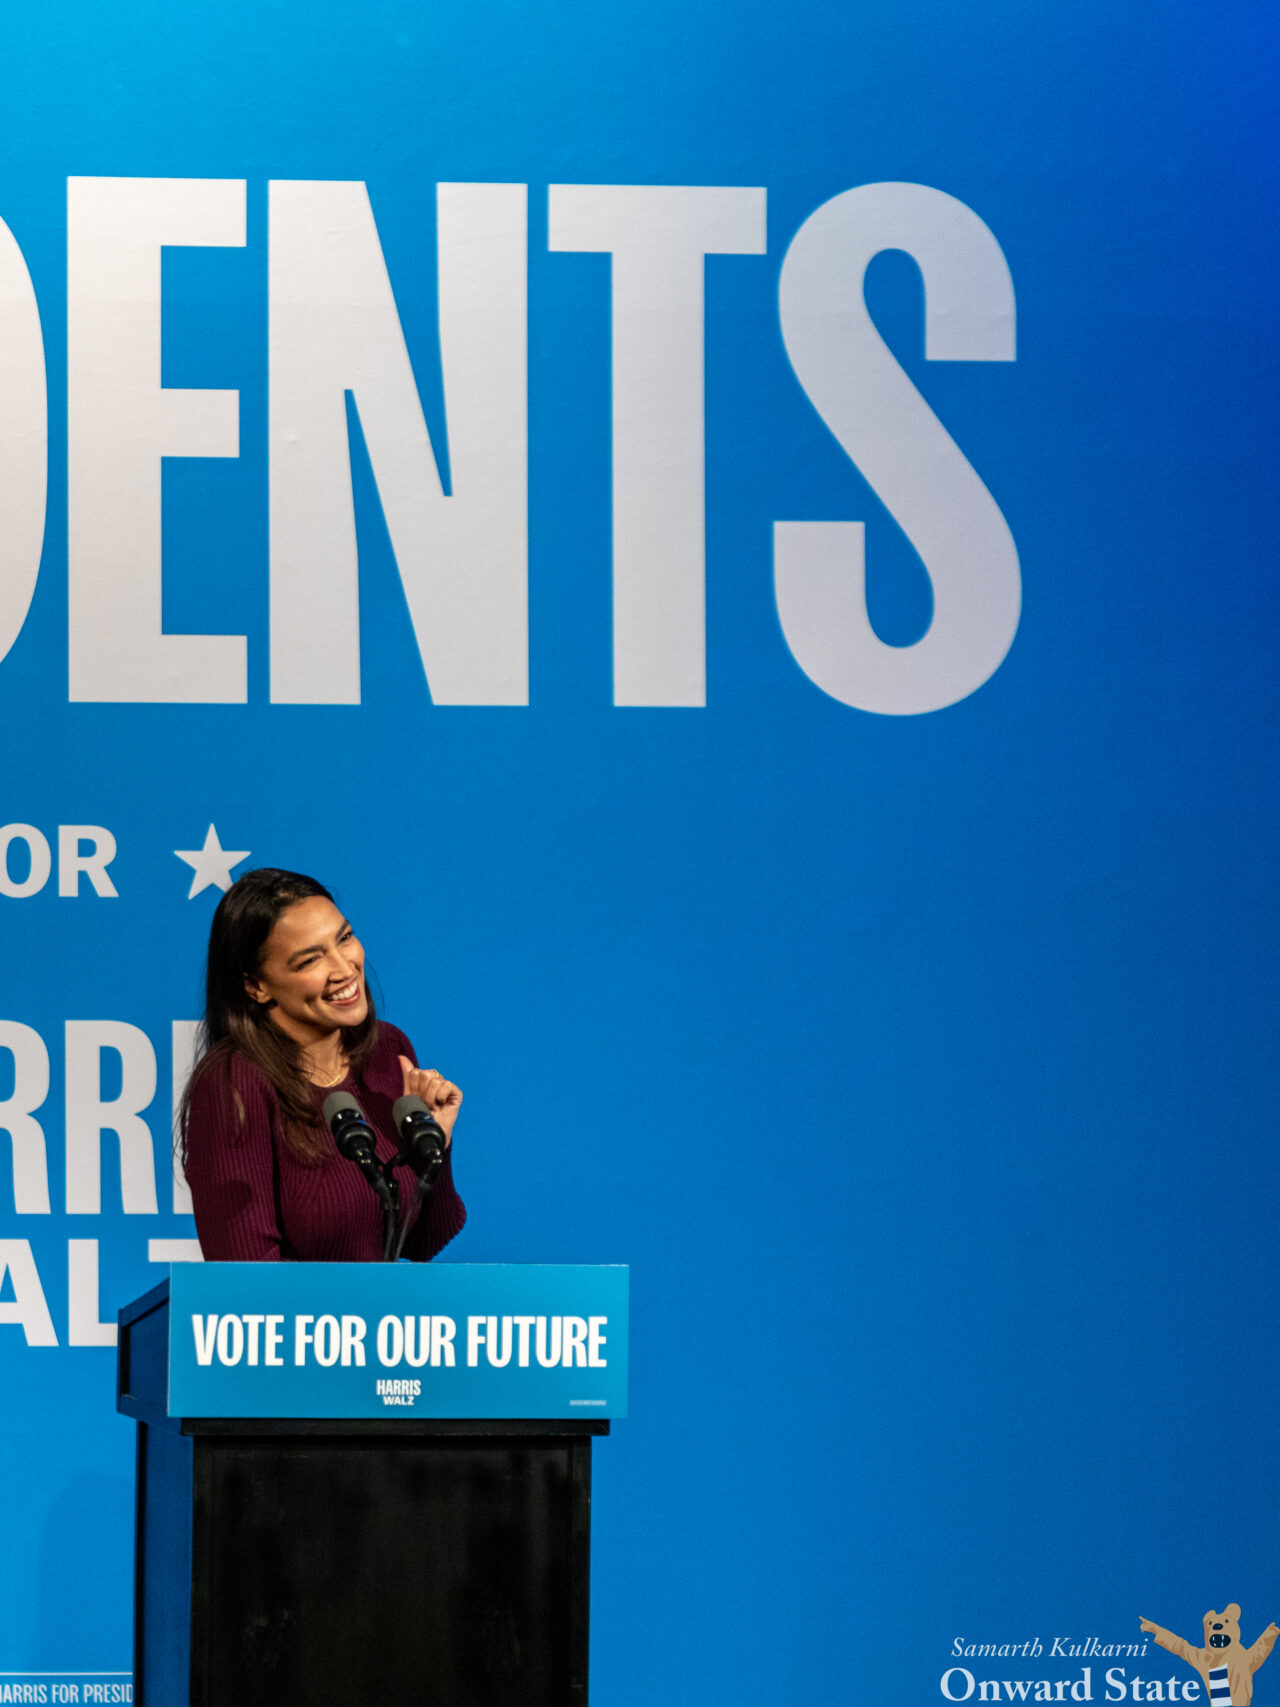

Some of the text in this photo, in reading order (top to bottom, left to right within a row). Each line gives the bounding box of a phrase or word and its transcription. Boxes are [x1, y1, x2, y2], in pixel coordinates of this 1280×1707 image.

[191, 1313, 608, 1368] VOTE FOR OUR FUTURE
[376, 1379, 422, 1396] HARRIS
[382, 1396, 415, 1406] WALZ
[51, 1683, 79, 1703] FOR
